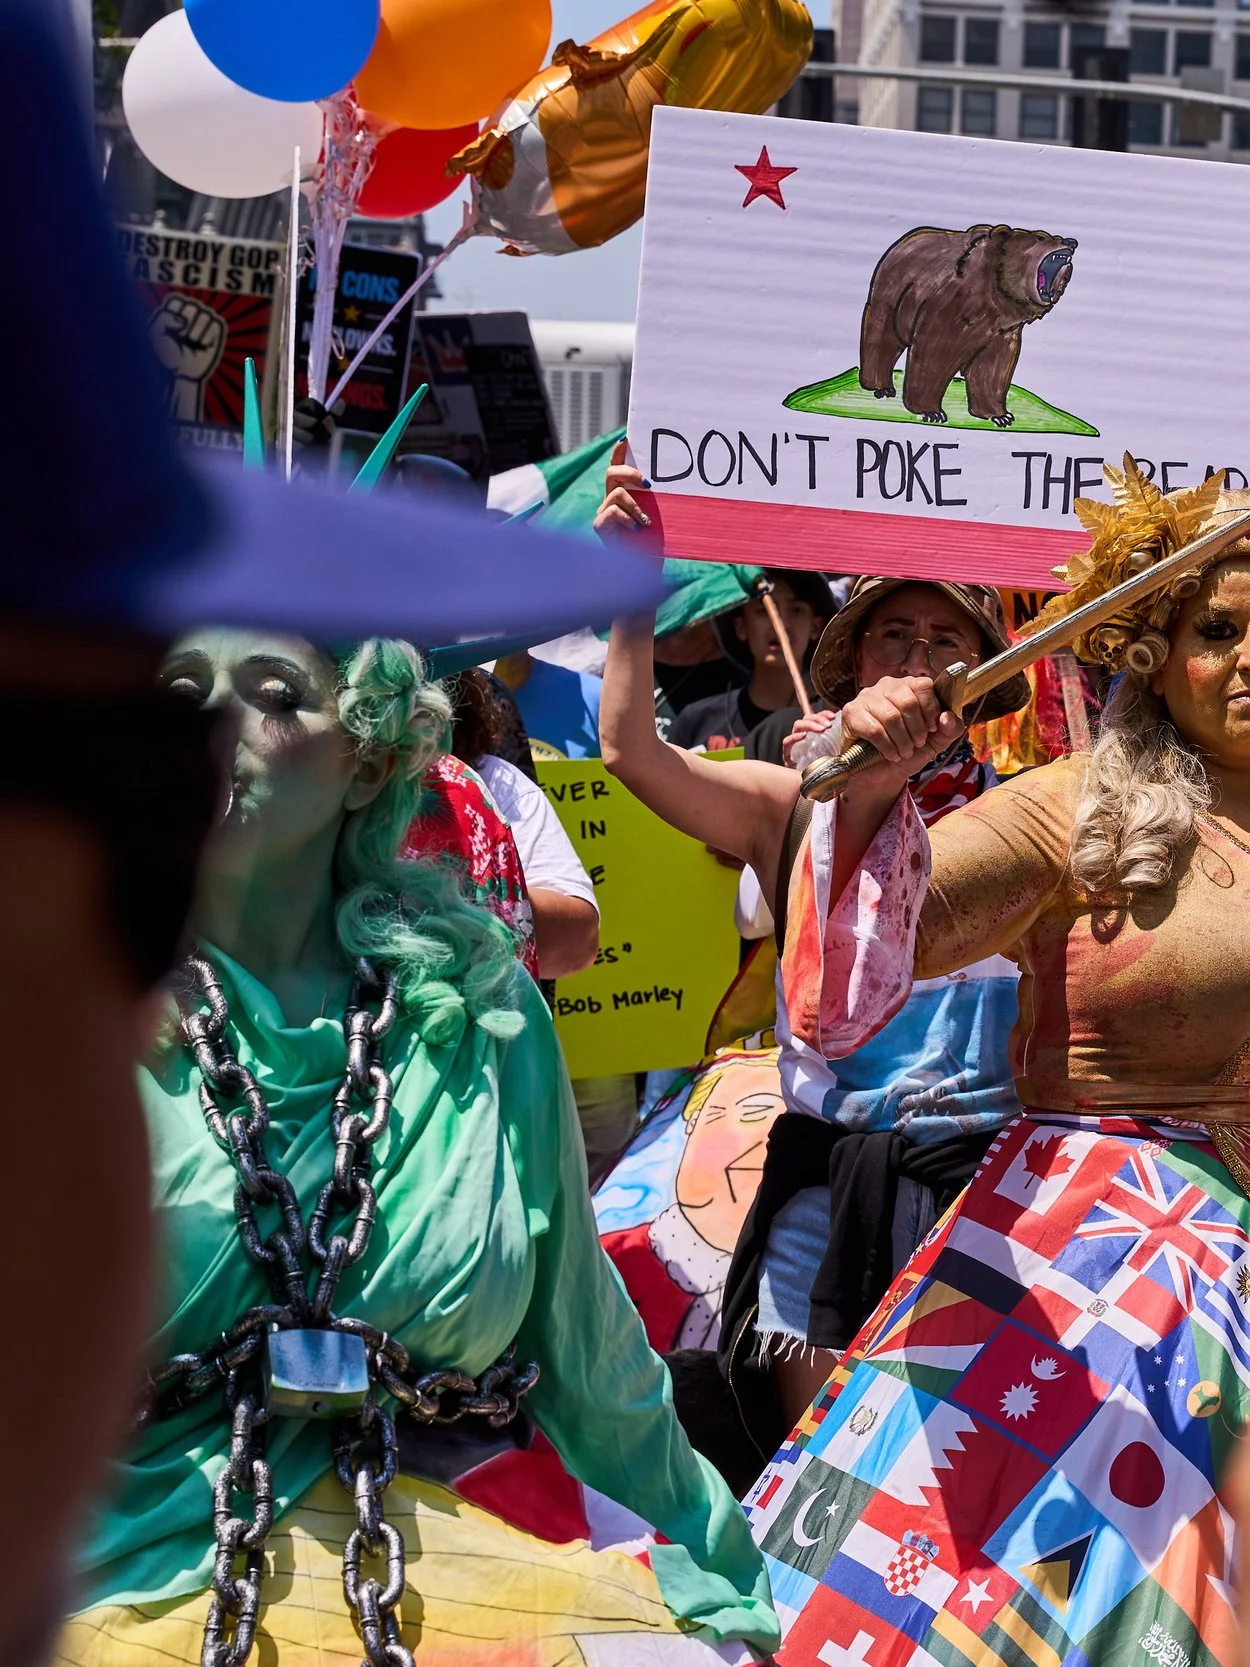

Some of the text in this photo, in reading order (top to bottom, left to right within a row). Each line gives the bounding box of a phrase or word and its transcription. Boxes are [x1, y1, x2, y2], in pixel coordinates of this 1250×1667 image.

[118, 230, 279, 271] DESTROY GOP
[132, 256, 276, 295] ASCISM
[650, 428, 829, 490] DON'T
[856, 439, 968, 506] POKE
[1011, 450, 1104, 515] THE
[580, 820, 606, 839] IN
[612, 986, 683, 1011] Marley
